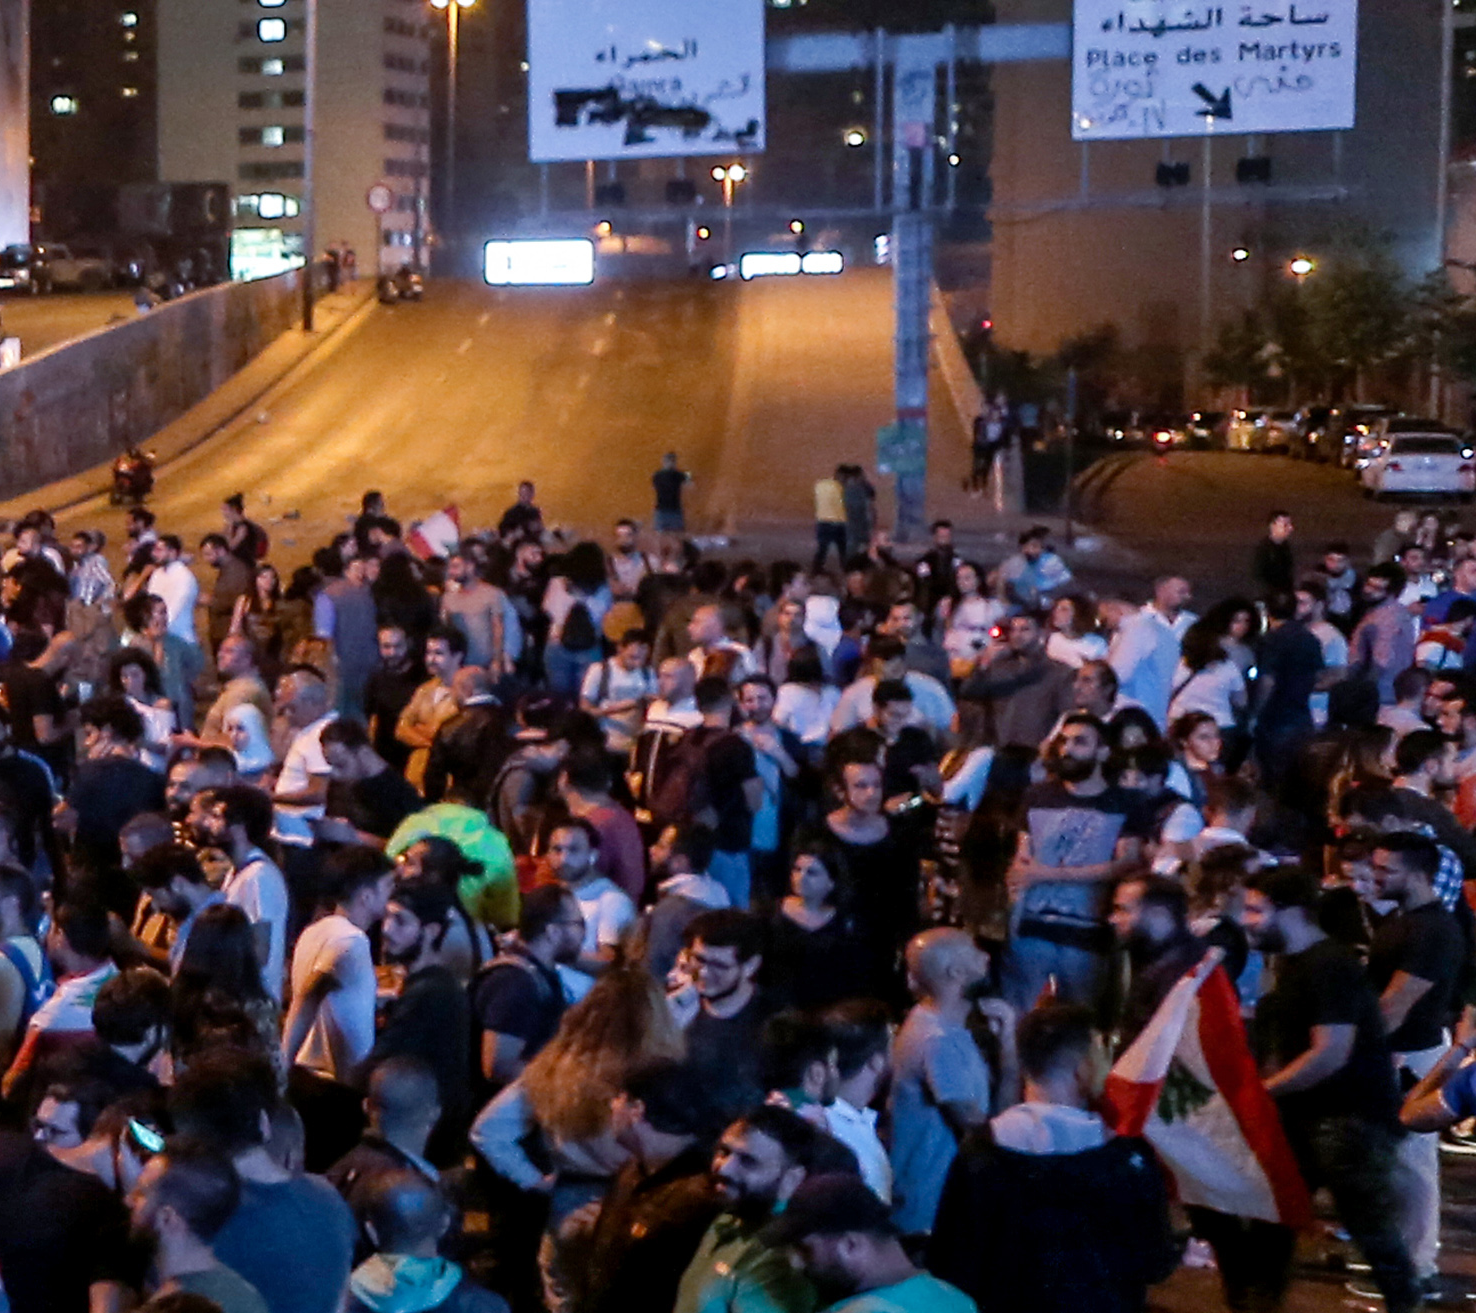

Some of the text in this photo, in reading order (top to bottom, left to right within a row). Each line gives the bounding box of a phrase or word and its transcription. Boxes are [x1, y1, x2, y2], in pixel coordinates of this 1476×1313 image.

[1100, 4, 1330, 38] ساحة الشهداء
[594, 38, 699, 70] الحمراء
[1087, 40, 1343, 69] Place des Martyrs
